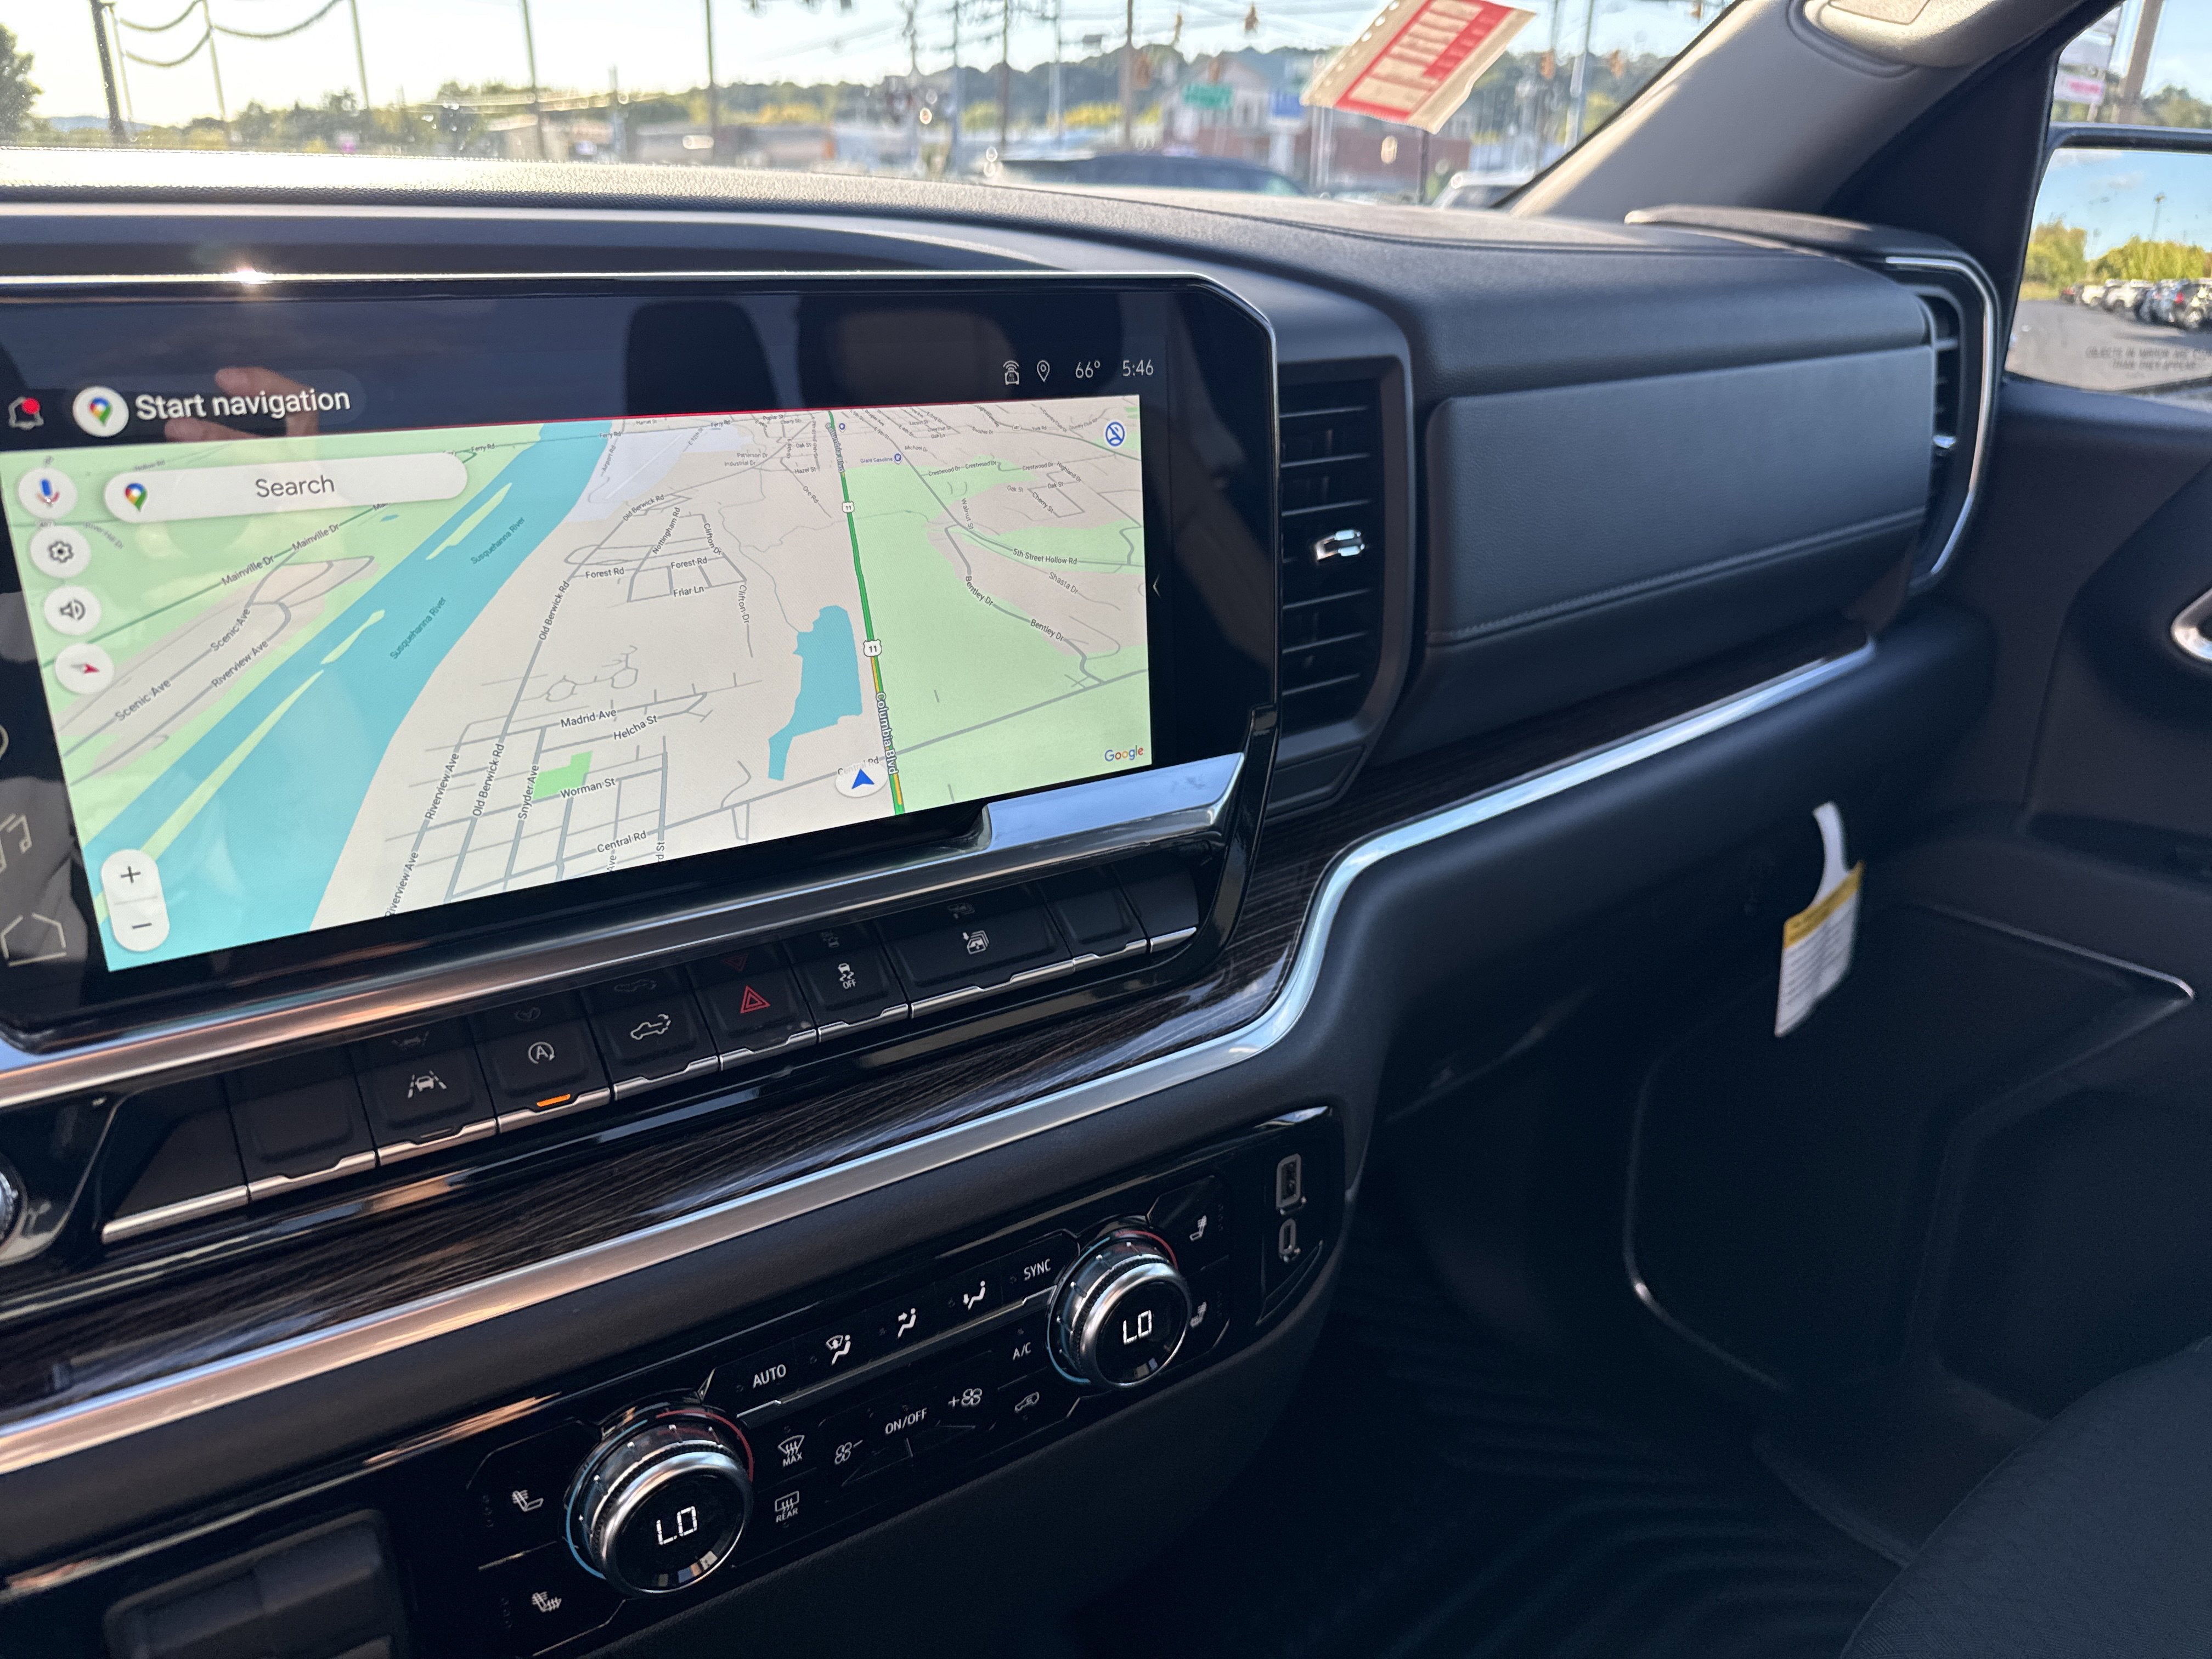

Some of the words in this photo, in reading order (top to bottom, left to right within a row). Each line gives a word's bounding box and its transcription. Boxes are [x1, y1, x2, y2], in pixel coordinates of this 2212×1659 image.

[1122, 359, 1154, 376] 5:46
[136, 393, 206, 420] Start
[212, 390, 351, 419] navigation
[603, 450, 613, 472] Airport
[610, 445, 617, 453] Rd
[825, 422, 842, 456] Columbia
[837, 456, 845, 472] Blvd
[965, 461, 990, 469] Crestwood
[1057, 461, 1076, 478] Highland
[256, 475, 335, 498] Search
[803, 486, 811, 496] Ore
[811, 494, 819, 504] Rd
[623, 511, 632, 522] Old
[631, 498, 654, 515] Berwick
[655, 494, 665, 503] Rd
[1032, 492, 1048, 509] Cherry
[961, 498, 973, 522] Walnut
[968, 522, 974, 530] St
[292, 529, 329, 551] Mainville
[329, 523, 340, 533] Dr
[471, 531, 511, 564] Susquehanna
[510, 517, 525, 533] River
[652, 517, 678, 555] Nottingham
[673, 507, 680, 518] Rd
[704, 523, 715, 550] Clifton
[713, 545, 723, 555] Dr
[670, 559, 696, 569] Forest
[697, 557, 708, 566] Rd
[1013, 549, 1024, 557] 5th
[1024, 552, 1044, 562] Street
[1045, 556, 1068, 564] Hollow
[222, 561, 264, 585] Mainville
[263, 555, 275, 566] Dr
[585, 570, 612, 579] Forest
[613, 567, 625, 575] Rd
[673, 588, 693, 597] Friar
[694, 585, 704, 594] Ln
[965, 575, 985, 602] Bentley
[983, 595, 994, 607] Dr
[1049, 572, 1071, 590] Shasta
[1069, 585, 1079, 595] Dr
[538, 626, 549, 641] Old
[545, 594, 563, 627] Berwick
[558, 580, 569, 594] Rd
[737, 584, 747, 613] Clifton
[742, 613, 750, 624] Dr
[210, 626, 237, 652] Scenic
[236, 608, 251, 630] Ave
[390, 615, 432, 659] Susquehanna
[429, 597, 447, 617] River
[1030, 618, 1056, 637] Bentley
[1054, 631, 1065, 641] Dr
[868, 645, 878, 653] 11
[211, 656, 252, 688] Riverview
[251, 640, 269, 657] Ave
[115, 695, 151, 721] Scenic
[151, 679, 172, 697] Ave
[560, 713, 596, 729] Madrid
[596, 708, 617, 721] Ave
[613, 719, 647, 741] Helcha
[646, 715, 658, 727] St
[875, 692, 893, 747] Columbia
[884, 748, 899, 775] Blvd
[493, 743, 505, 760] Rd
[1104, 745, 1144, 762] Google
[837, 759, 867, 776] Central
[867, 756, 879, 765] Rd
[425, 772, 452, 820] Riverview
[445, 752, 460, 776] Ave
[477, 756, 500, 801] Berwick
[560, 780, 605, 799] Worman
[604, 777, 616, 789] St
[518, 783, 535, 820] Snyder
[527, 765, 540, 785] Ave
[472, 798, 486, 817] Old
[597, 837, 631, 854] Central
[632, 831, 647, 842] Rd
[655, 841, 665, 851] St
[606, 855, 617, 873] Ave
[385, 869, 410, 917] Riverview
[405, 851, 419, 872] Ave
[842, 979, 856, 990] OFF
[1023, 1258, 1052, 1281] SYNC
[1012, 1342, 1031, 1361] A/C
[752, 1364, 787, 1389] AUTO
[885, 1408, 928, 1435] ON/OFF
[782, 1451, 803, 1467] MAX
[775, 1507, 799, 1523] REAR
